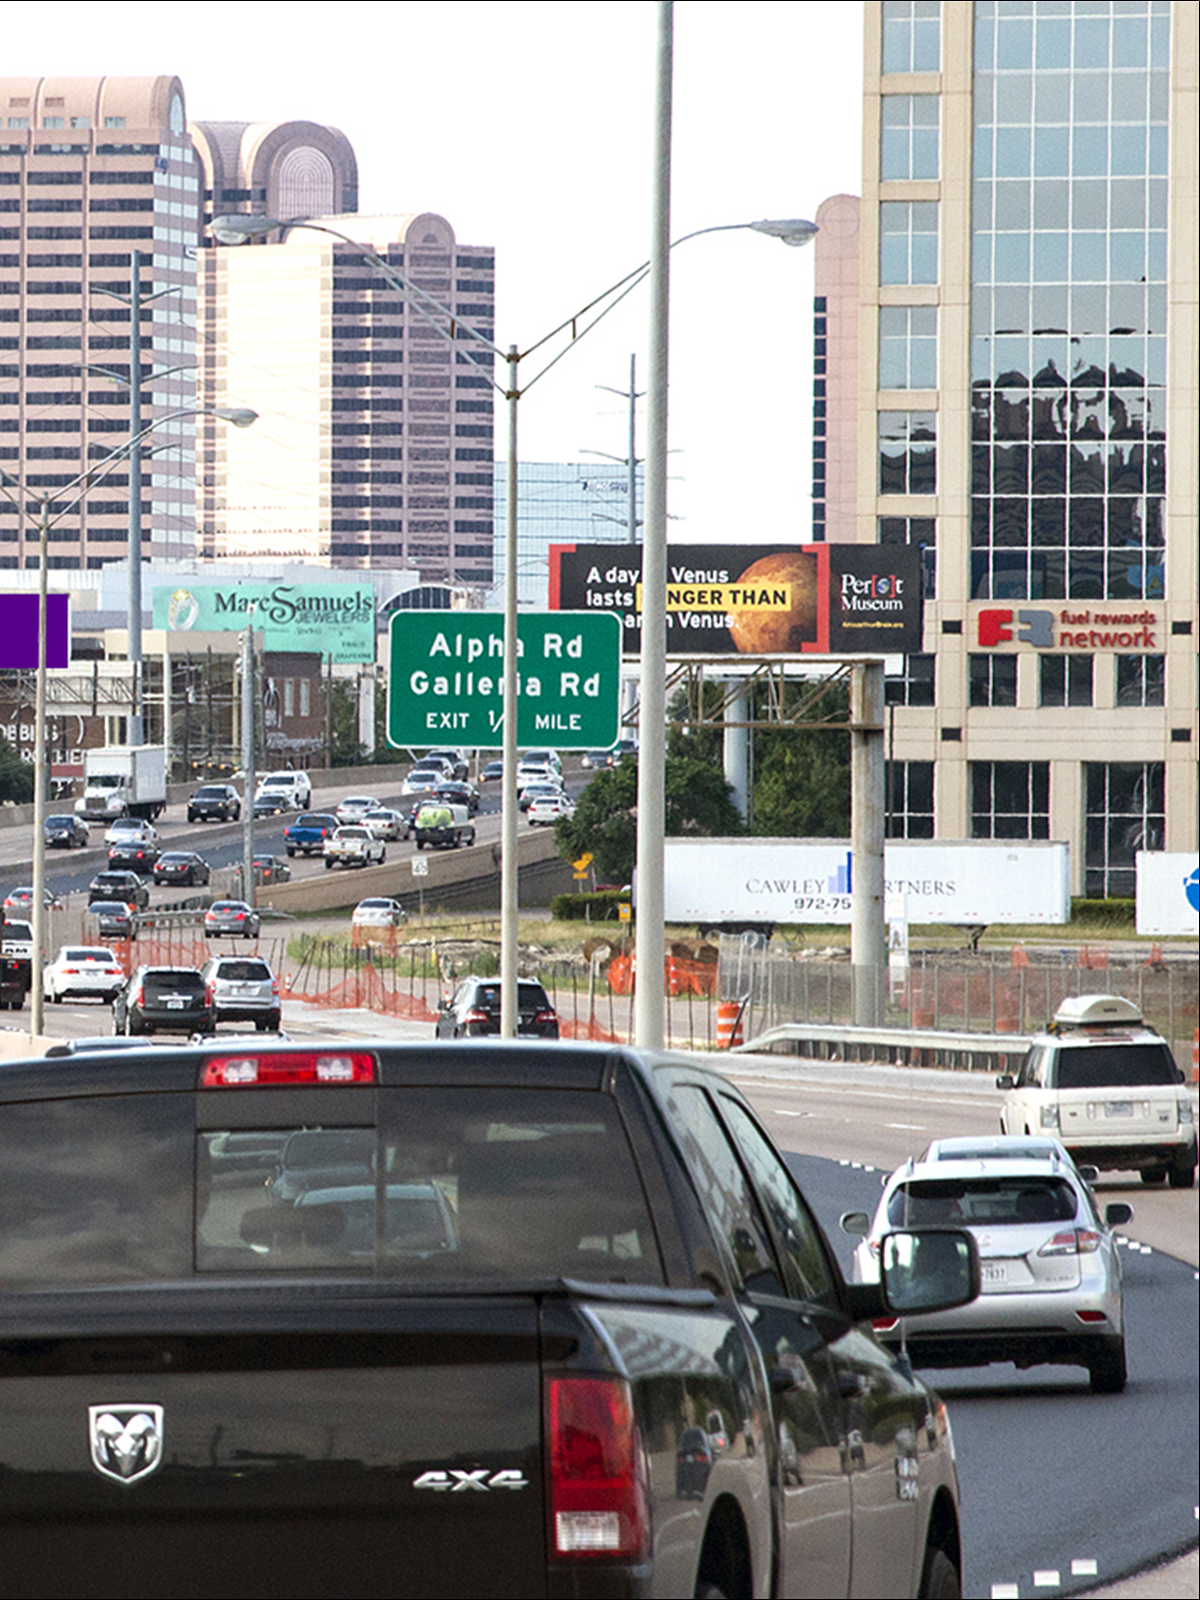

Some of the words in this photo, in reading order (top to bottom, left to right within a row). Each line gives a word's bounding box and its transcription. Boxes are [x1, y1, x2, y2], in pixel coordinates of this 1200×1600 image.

[587, 567, 601, 583] A
[605, 567, 640, 586] day
[671, 567, 729, 583] Venus
[586, 590, 633, 606] lasts
[667, 590, 723, 605] NGER
[729, 590, 787, 605] THAN
[841, 595, 904, 610] Museum
[295, 611, 370, 624] JEWELERS
[678, 612, 739, 629] Venus.
[1060, 610, 1089, 625] fuel
[1094, 610, 1156, 625] rewards
[1060, 627, 1156, 647] network
[429, 633, 525, 663] Alpha
[544, 633, 583, 658] Rd
[560, 672, 600, 697] Rd
[426, 712, 470, 729] EXIT
[535, 714, 582, 731] MILE
[745, 878, 826, 895] CAWLEY
[884, 879, 957, 896] RTNERS
